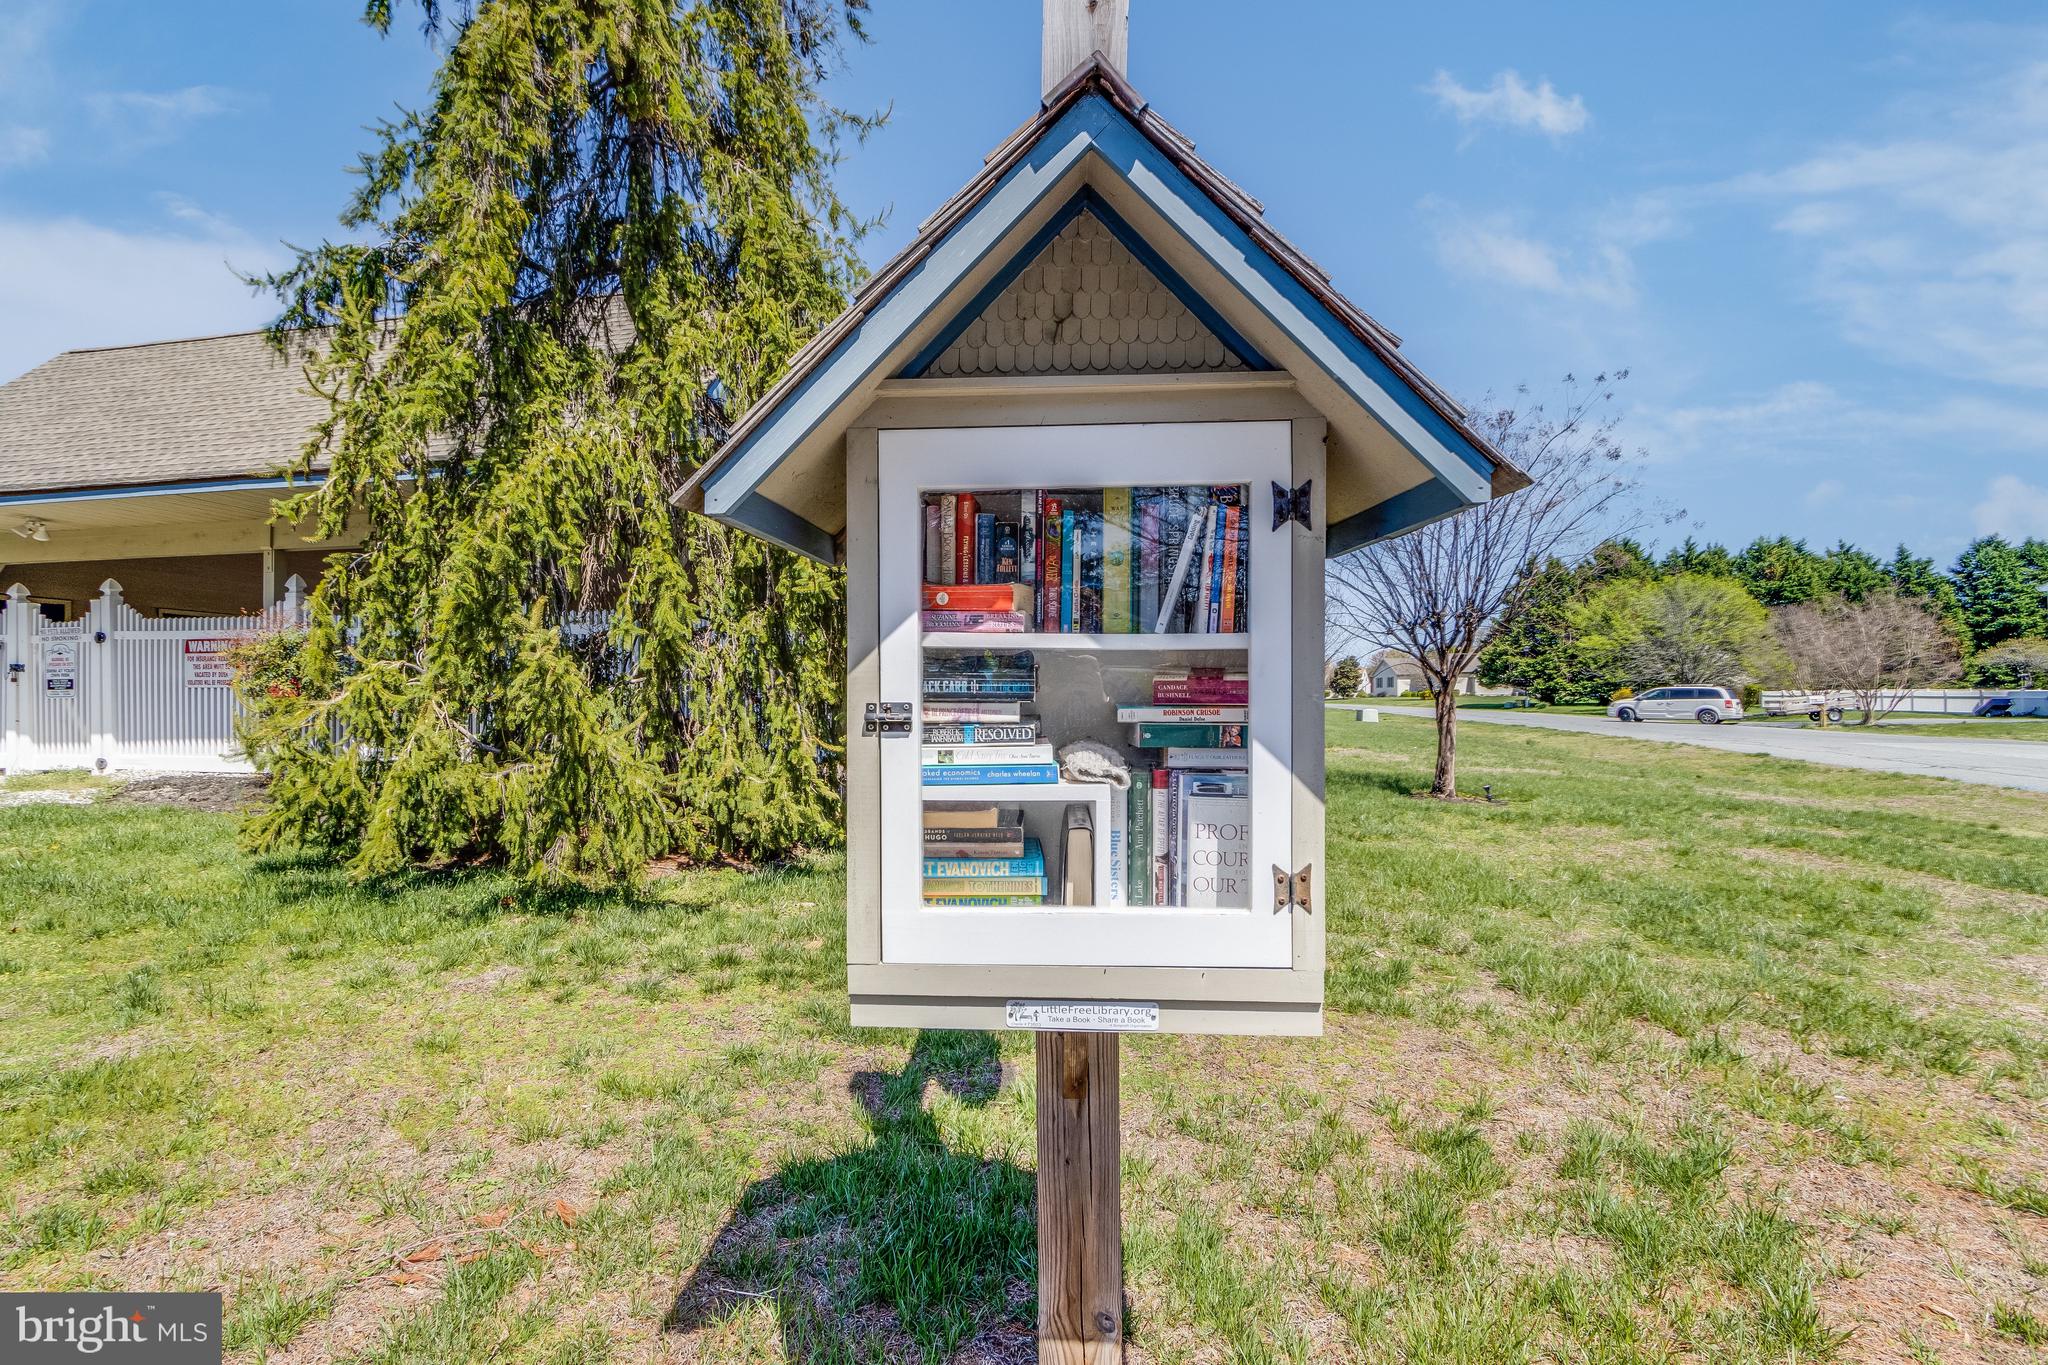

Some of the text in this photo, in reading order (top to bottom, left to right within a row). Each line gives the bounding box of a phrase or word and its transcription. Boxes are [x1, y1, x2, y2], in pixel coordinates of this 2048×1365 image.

[1168, 486, 1180, 583] BRUCE SPRINGSTE
[943, 532, 953, 562] BROWN
[996, 565, 1017, 573] FOLLETT
[1001, 557, 1013, 565] KEN
[943, 680, 968, 692] CARR
[929, 734, 964, 742] TANENBAUM
[974, 727, 1032, 743] RESOLVED
[987, 769, 1011, 778] charles
[1013, 769, 1041, 777] wheelan
[1135, 800, 1144, 830] Patchett
[1195, 823, 1248, 840] PROF
[1135, 833, 1144, 850] Ann
[1110, 830, 1121, 900] Blue Sisters
[1193, 849, 1248, 867] COUR
[937, 861, 1009, 876] EVANOVICH
[969, 881, 985, 892] TO
[1003, 881, 1033, 892] NINES
[1135, 879, 1144, 896] Lake
[1193, 876, 1238, 893] OUR
[1040, 1004, 1151, 1017] LittleFreeLibrary.org
[1127, 1016, 1145, 1024] Book
